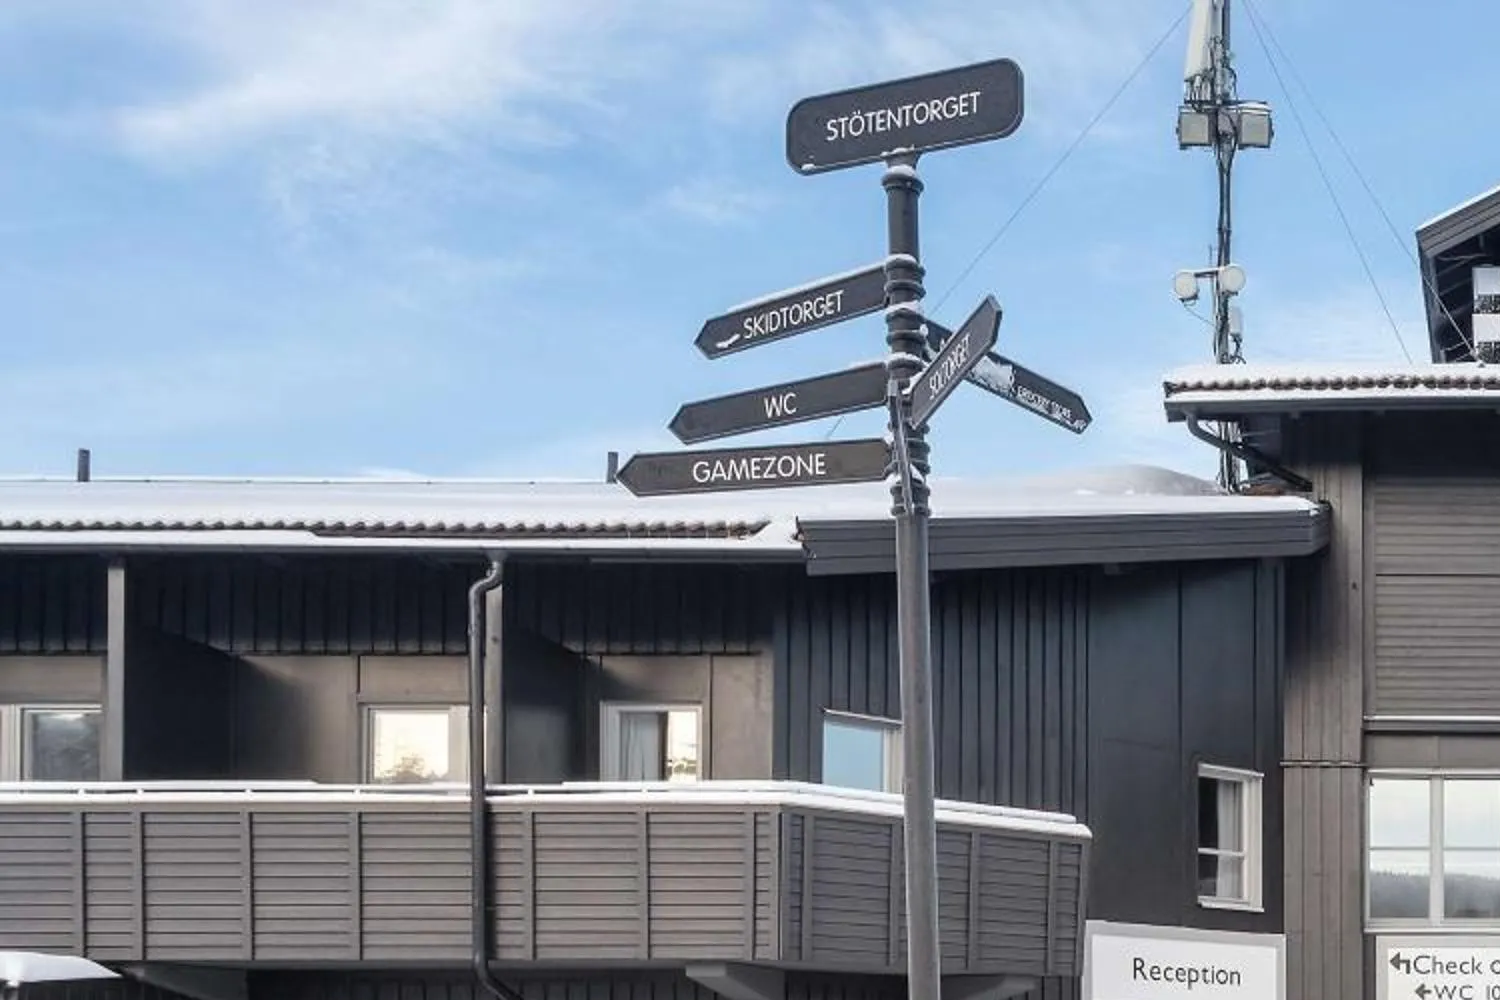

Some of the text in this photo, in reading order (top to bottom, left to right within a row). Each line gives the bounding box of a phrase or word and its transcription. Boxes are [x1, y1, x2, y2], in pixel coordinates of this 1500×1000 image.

[825, 90, 981, 141] STÖTENTORGET
[742, 289, 844, 340] SKIDTORGET
[763, 392, 797, 418] WC
[692, 453, 826, 484] GAMEZONE
[1132, 957, 1241, 990] Reception
[1413, 955, 1483, 975] Check
[1434, 984, 1473, 1000] WC
